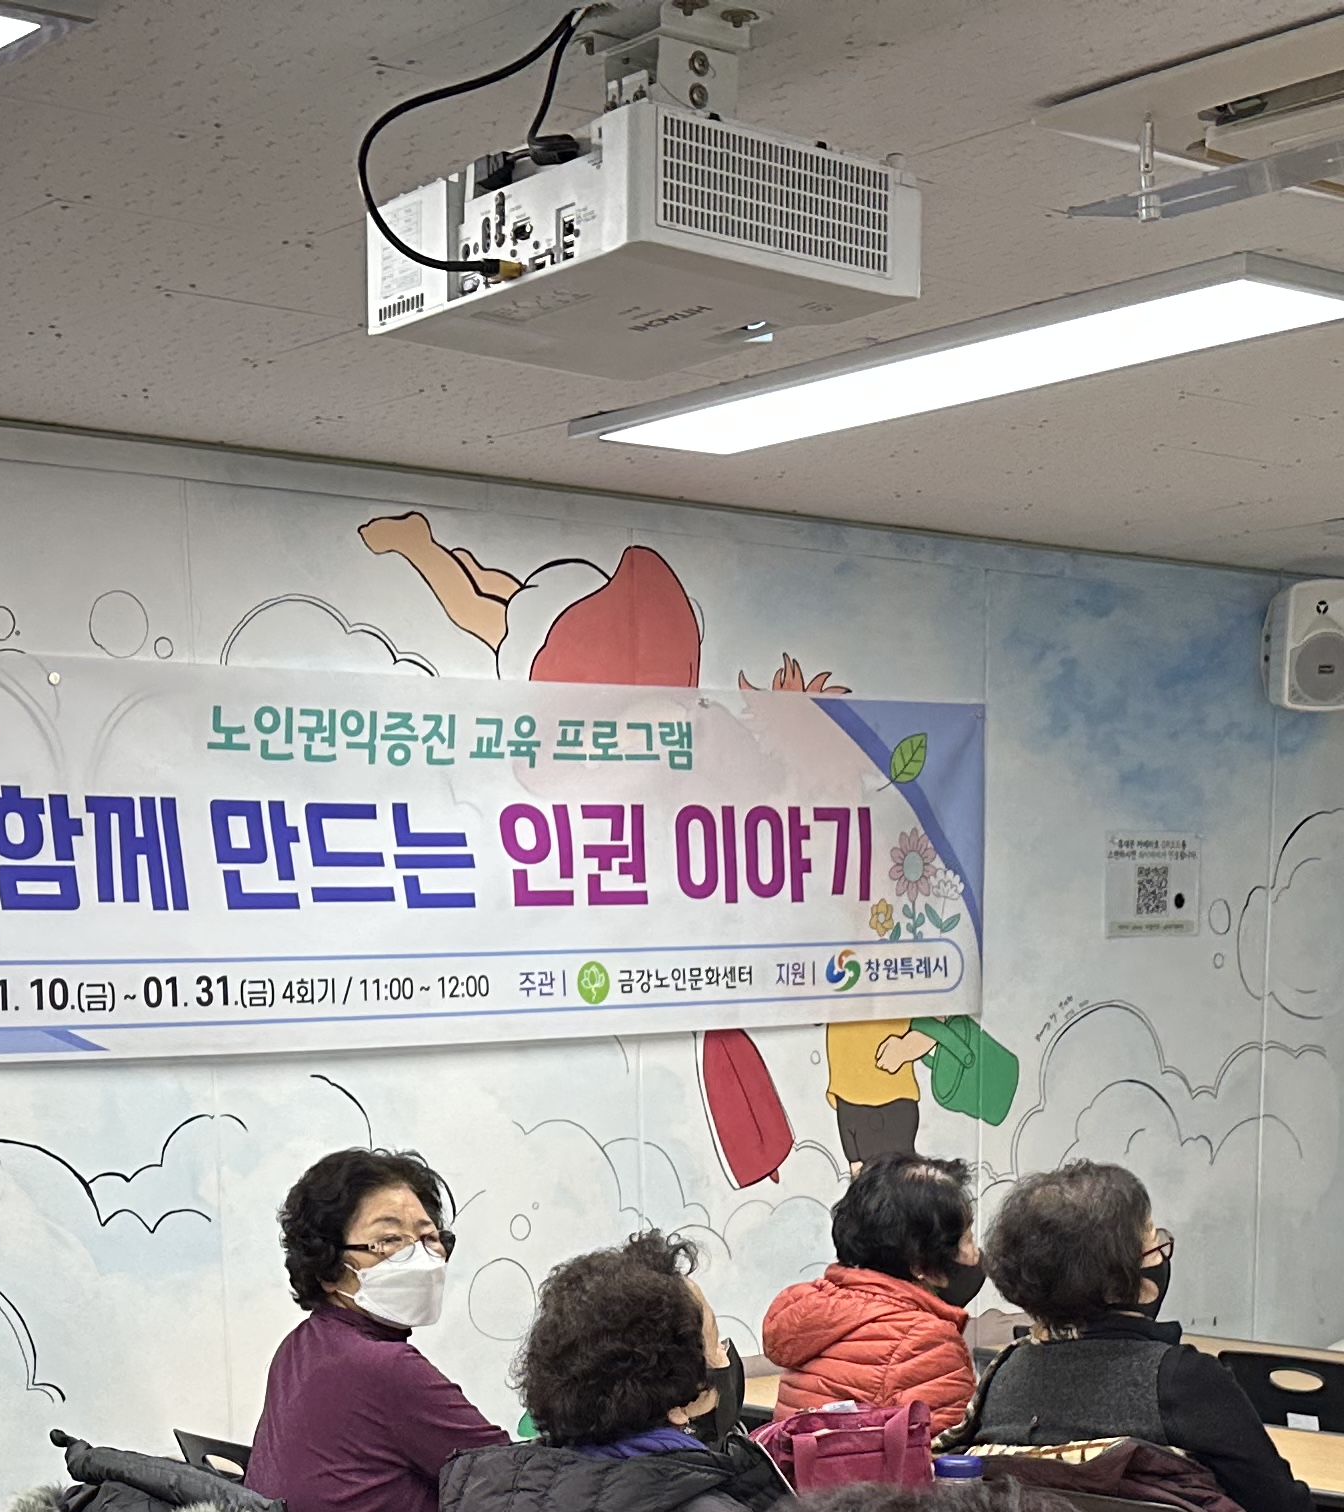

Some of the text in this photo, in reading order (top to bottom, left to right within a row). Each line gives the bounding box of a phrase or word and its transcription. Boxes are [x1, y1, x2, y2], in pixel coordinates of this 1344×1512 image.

[207, 704, 693, 771] 노인권익증진 교육 프로그램
[210, 799, 476, 911] 만드는
[499, 802, 649, 906] 인권
[675, 804, 873, 904] 이야기
[519, 964, 753, 998] 주관 금강노인문화센터
[775, 955, 948, 987] 지원 창원특례시
[143, 976, 189, 1009] 01.
[282, 977, 337, 1005] 4회기
[360, 976, 414, 1002] 11:00
[438, 974, 490, 999] 12:00
